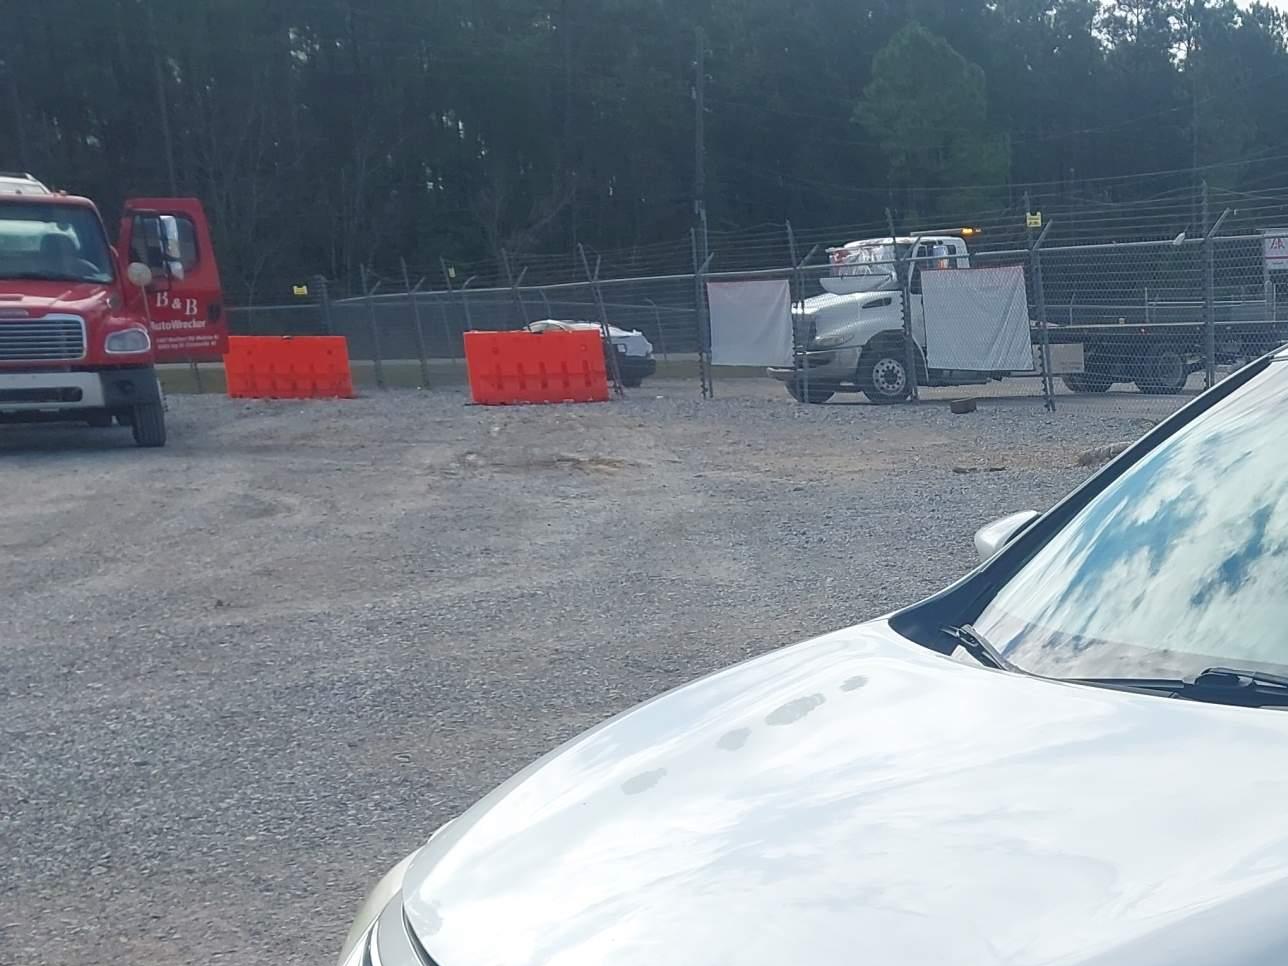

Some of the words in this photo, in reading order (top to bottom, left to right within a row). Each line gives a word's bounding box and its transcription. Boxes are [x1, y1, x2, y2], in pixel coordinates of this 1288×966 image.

[156, 291, 169, 308] B
[171, 297, 182, 310] &
[184, 298, 198, 315] B
